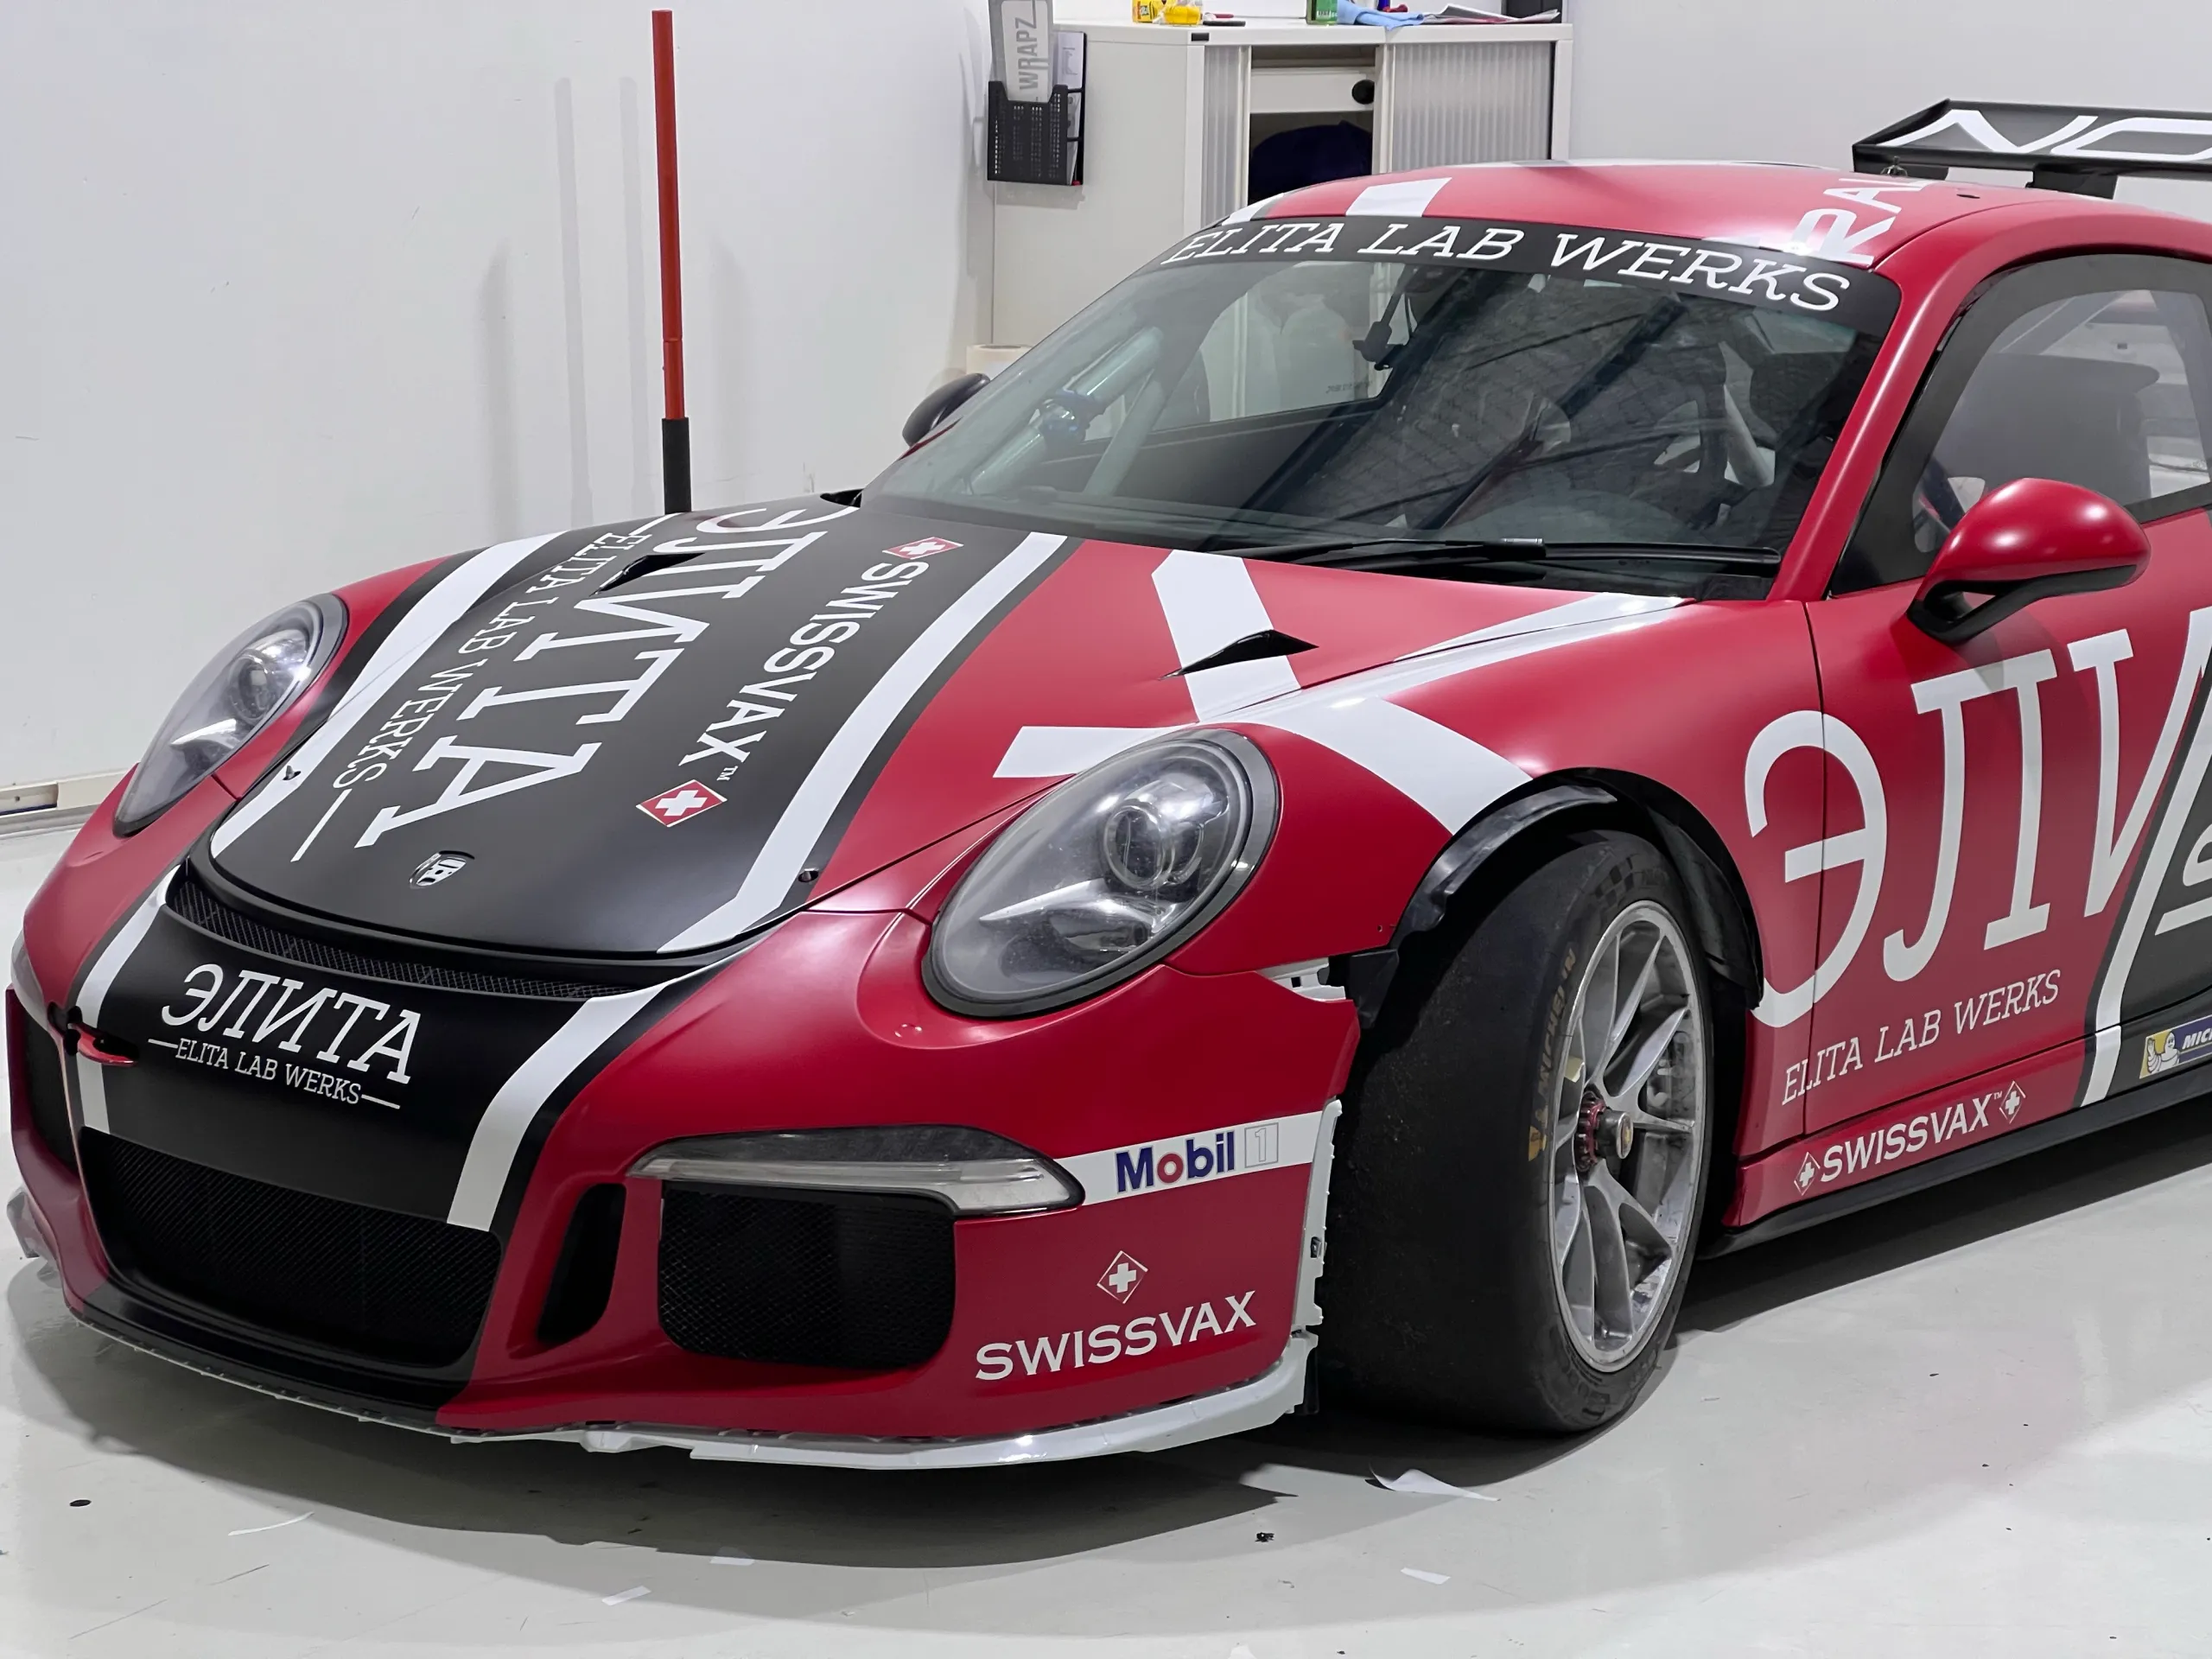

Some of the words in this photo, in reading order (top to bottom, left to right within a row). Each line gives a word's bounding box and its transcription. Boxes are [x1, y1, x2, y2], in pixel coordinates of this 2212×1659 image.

[1015, 0, 1050, 90] WRAPZ
[1160, 223, 1344, 265] ELITA
[1357, 223, 1525, 260] LAB
[1550, 232, 1850, 312] WERKS
[525, 532, 652, 594] ELITA
[458, 596, 560, 654] LAB
[677, 562, 931, 766] SWISSVAX
[332, 658, 489, 789] WERKS
[162, 963, 422, 1084] ЭЛИТА
[1782, 1037, 1864, 1106] ELITA
[1874, 1009, 1942, 1063] LAB
[1954, 969, 2061, 1034] WERKS
[175, 1039, 228, 1070] ELITA
[234, 1051, 278, 1080] LAB
[285, 1063, 361, 1104] WERKS
[1115, 1130, 1236, 1194] Mobil
[1821, 1093, 1993, 1182] SWISSVAX
[976, 1290, 1257, 1381] SWISSVAX
